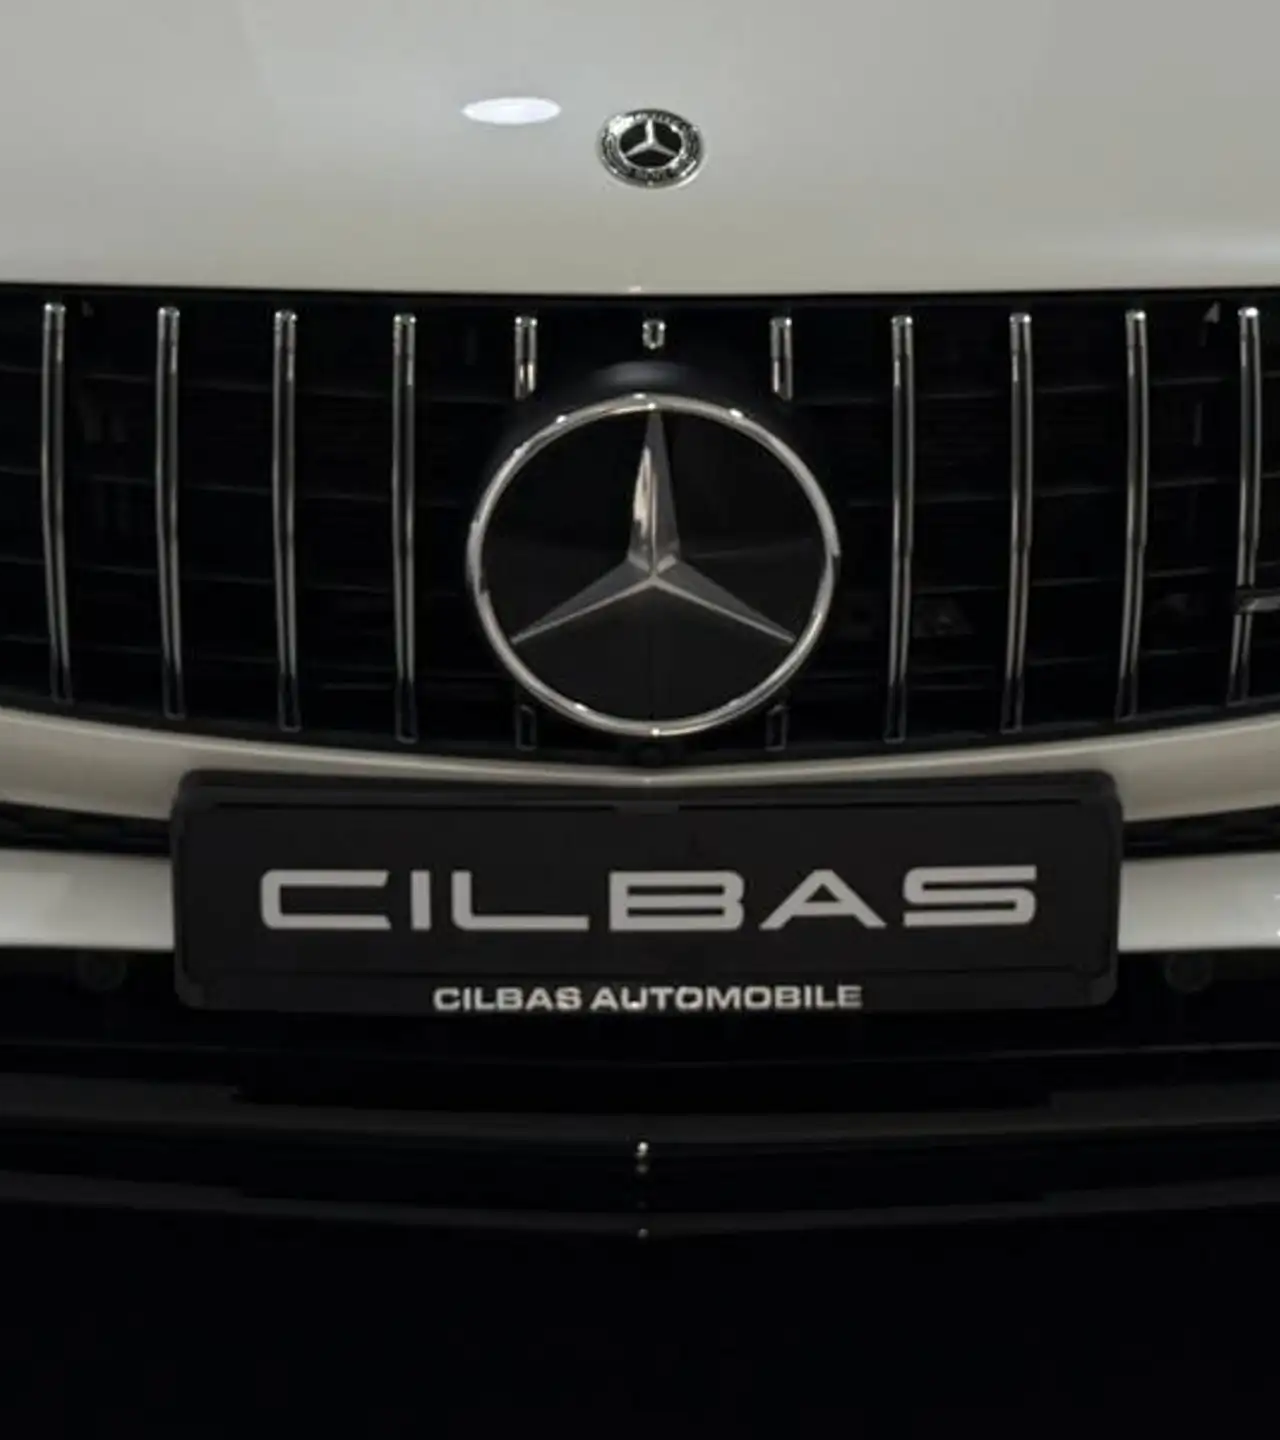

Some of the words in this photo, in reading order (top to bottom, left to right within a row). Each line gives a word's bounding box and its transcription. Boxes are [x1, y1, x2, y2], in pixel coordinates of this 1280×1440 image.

[261, 865, 1037, 931] CILBAS
[433, 986, 583, 1012] CILBAS
[589, 984, 862, 1012] AUTOMOBILE
